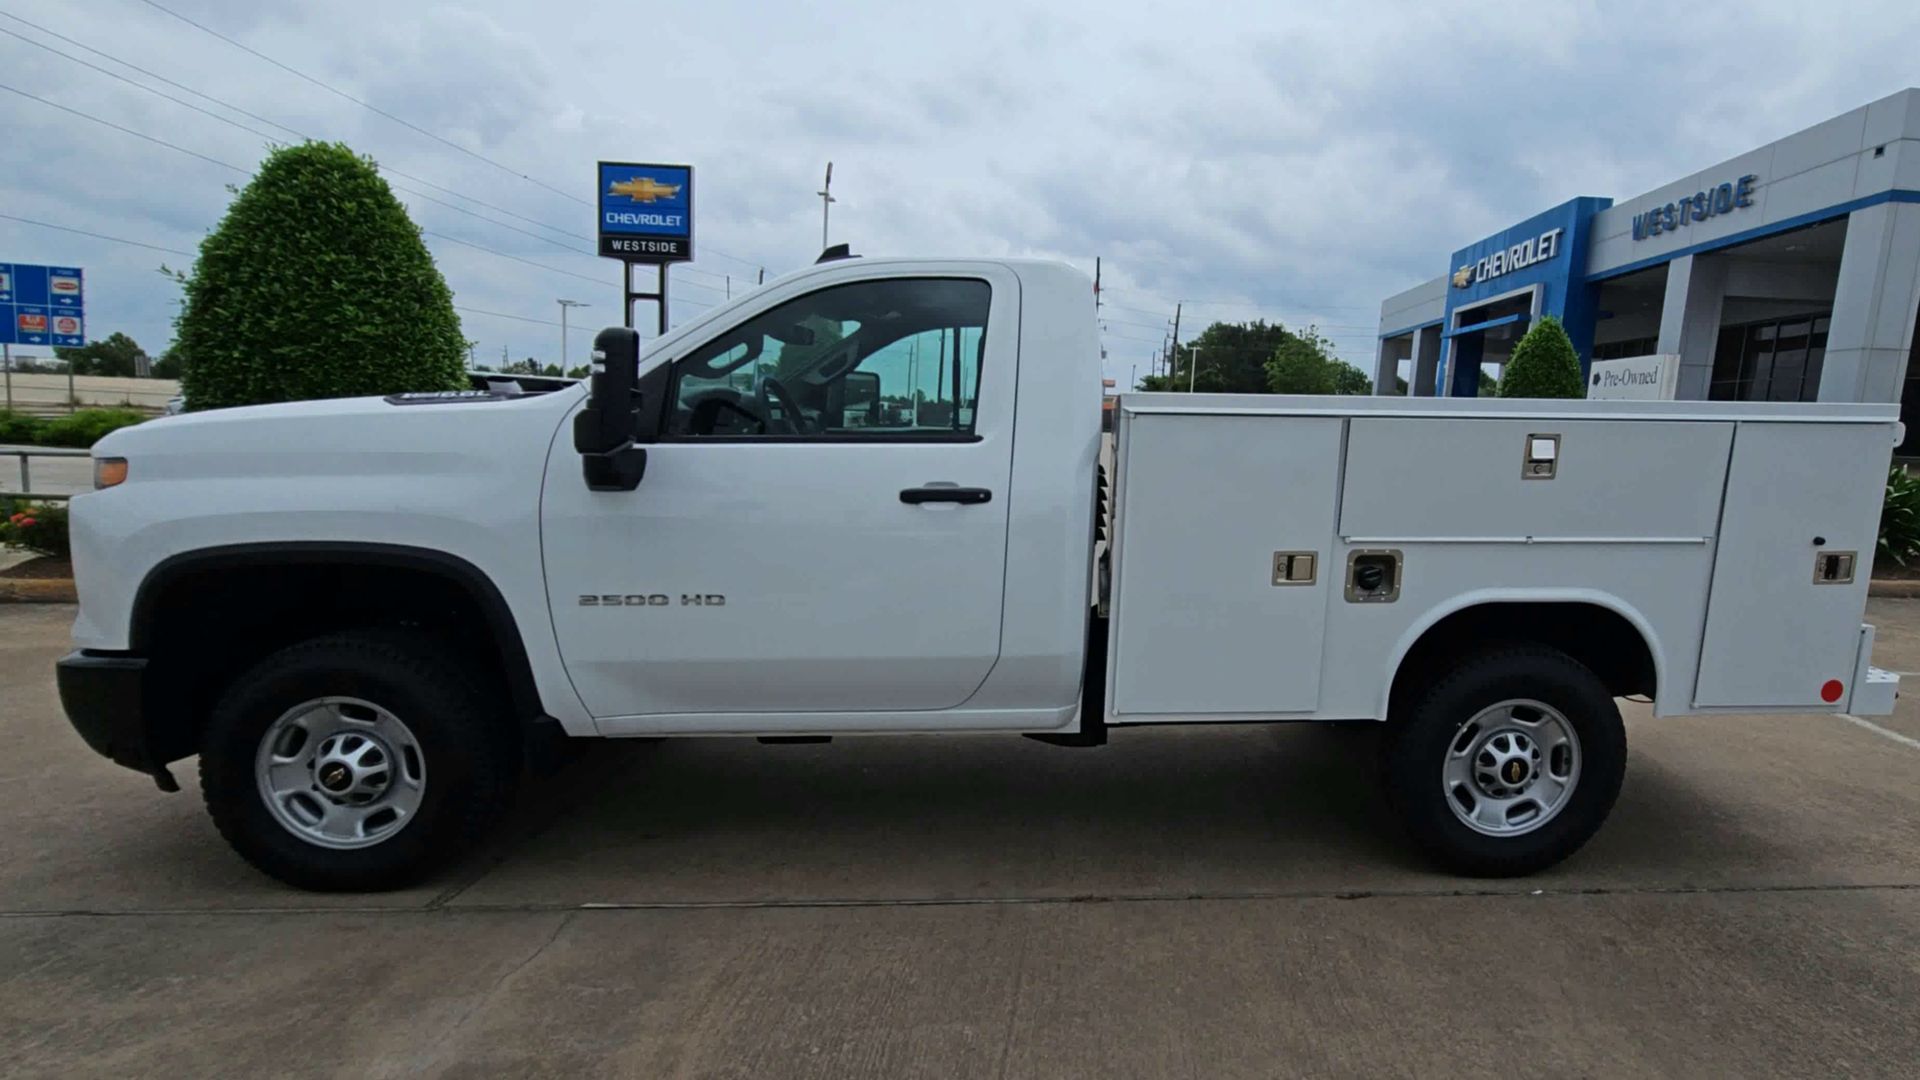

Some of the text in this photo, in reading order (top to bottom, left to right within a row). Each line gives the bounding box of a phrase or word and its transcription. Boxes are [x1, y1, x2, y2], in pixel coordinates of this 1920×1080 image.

[1632, 174, 1757, 241] WESTSIDE
[605, 212, 682, 226] CHEVROLET
[612, 240, 677, 253] WESTSIDE
[1475, 227, 1562, 283] CHEVROLET
[1603, 365, 1659, 387] Pre-Owned
[578, 594, 726, 606] 2500 HD
